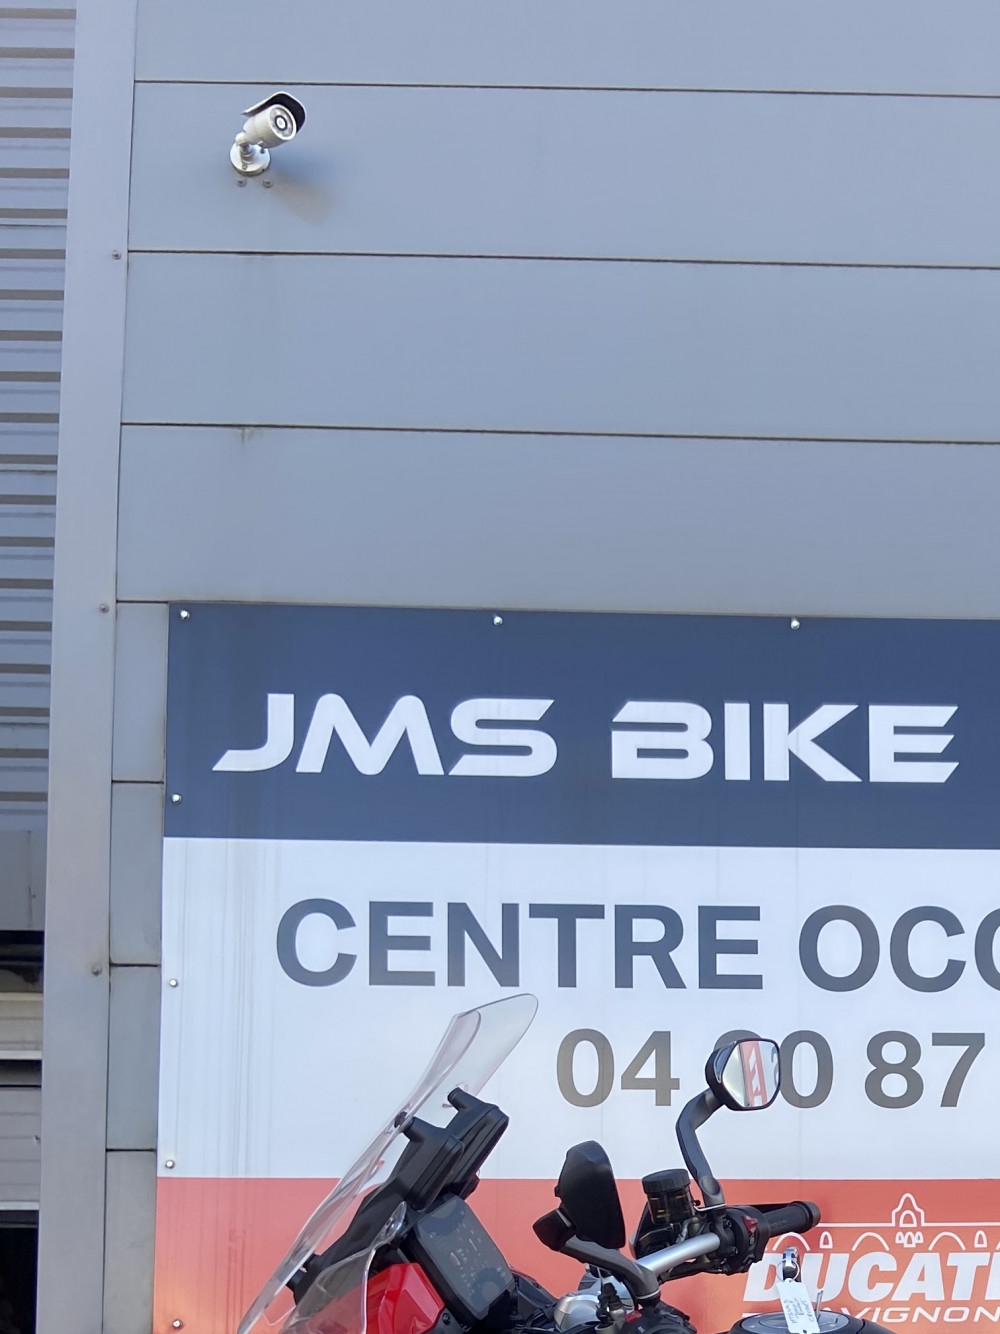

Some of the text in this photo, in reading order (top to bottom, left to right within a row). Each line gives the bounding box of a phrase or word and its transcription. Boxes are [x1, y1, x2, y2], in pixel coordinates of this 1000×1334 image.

[213, 693, 557, 777] JMS
[611, 701, 959, 783] BIKE
[276, 898, 763, 989] CENTRE
[556, 1028, 681, 1108] 04
[713, 1029, 834, 1109] 0
[865, 1030, 986, 1109] 87
